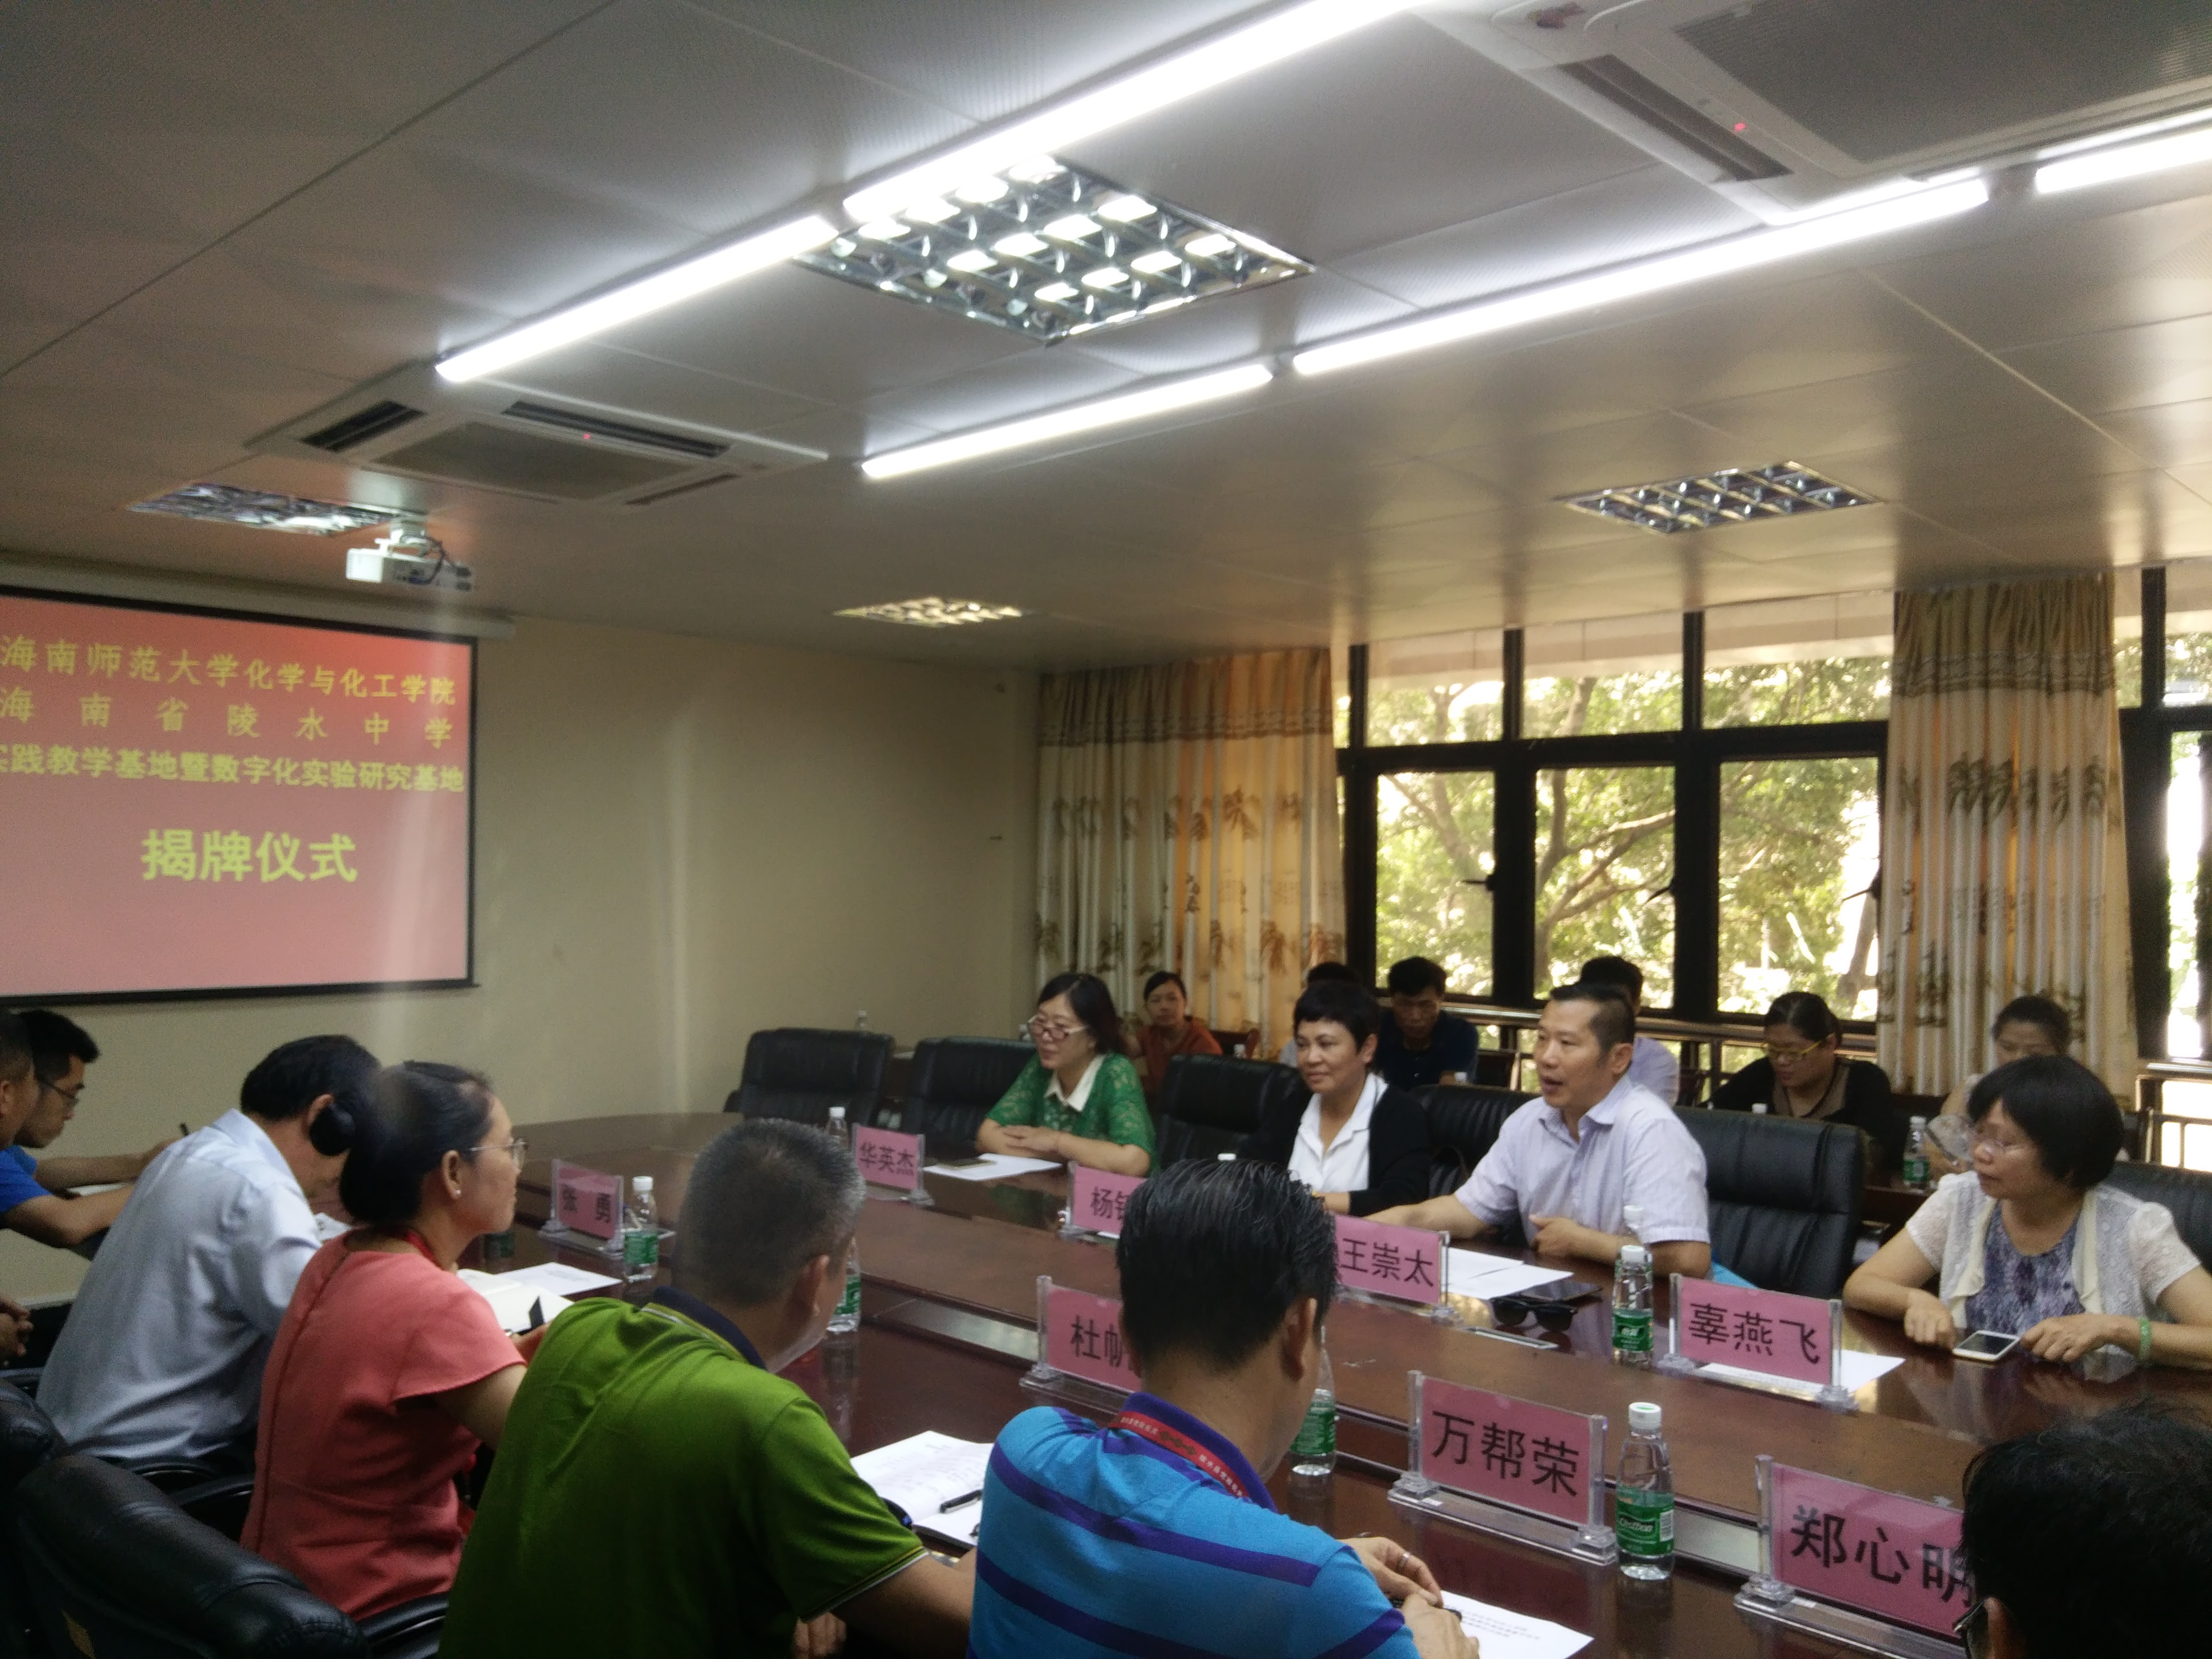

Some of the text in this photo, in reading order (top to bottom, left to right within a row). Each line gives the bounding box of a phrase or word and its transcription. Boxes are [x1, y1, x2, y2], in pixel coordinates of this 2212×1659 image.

[0, 634, 456, 706] 海南师范大学化学与化工学院
[141, 829, 358, 883] 揭牌仪式
[859, 1141, 915, 1177] 华英杰
[1340, 1238, 1434, 1287] 王崇太
[1689, 1303, 1820, 1364] 辜燕飞
[1432, 1410, 1579, 1496] 万帮荣
[1790, 1504, 1972, 1608] 郑心明
